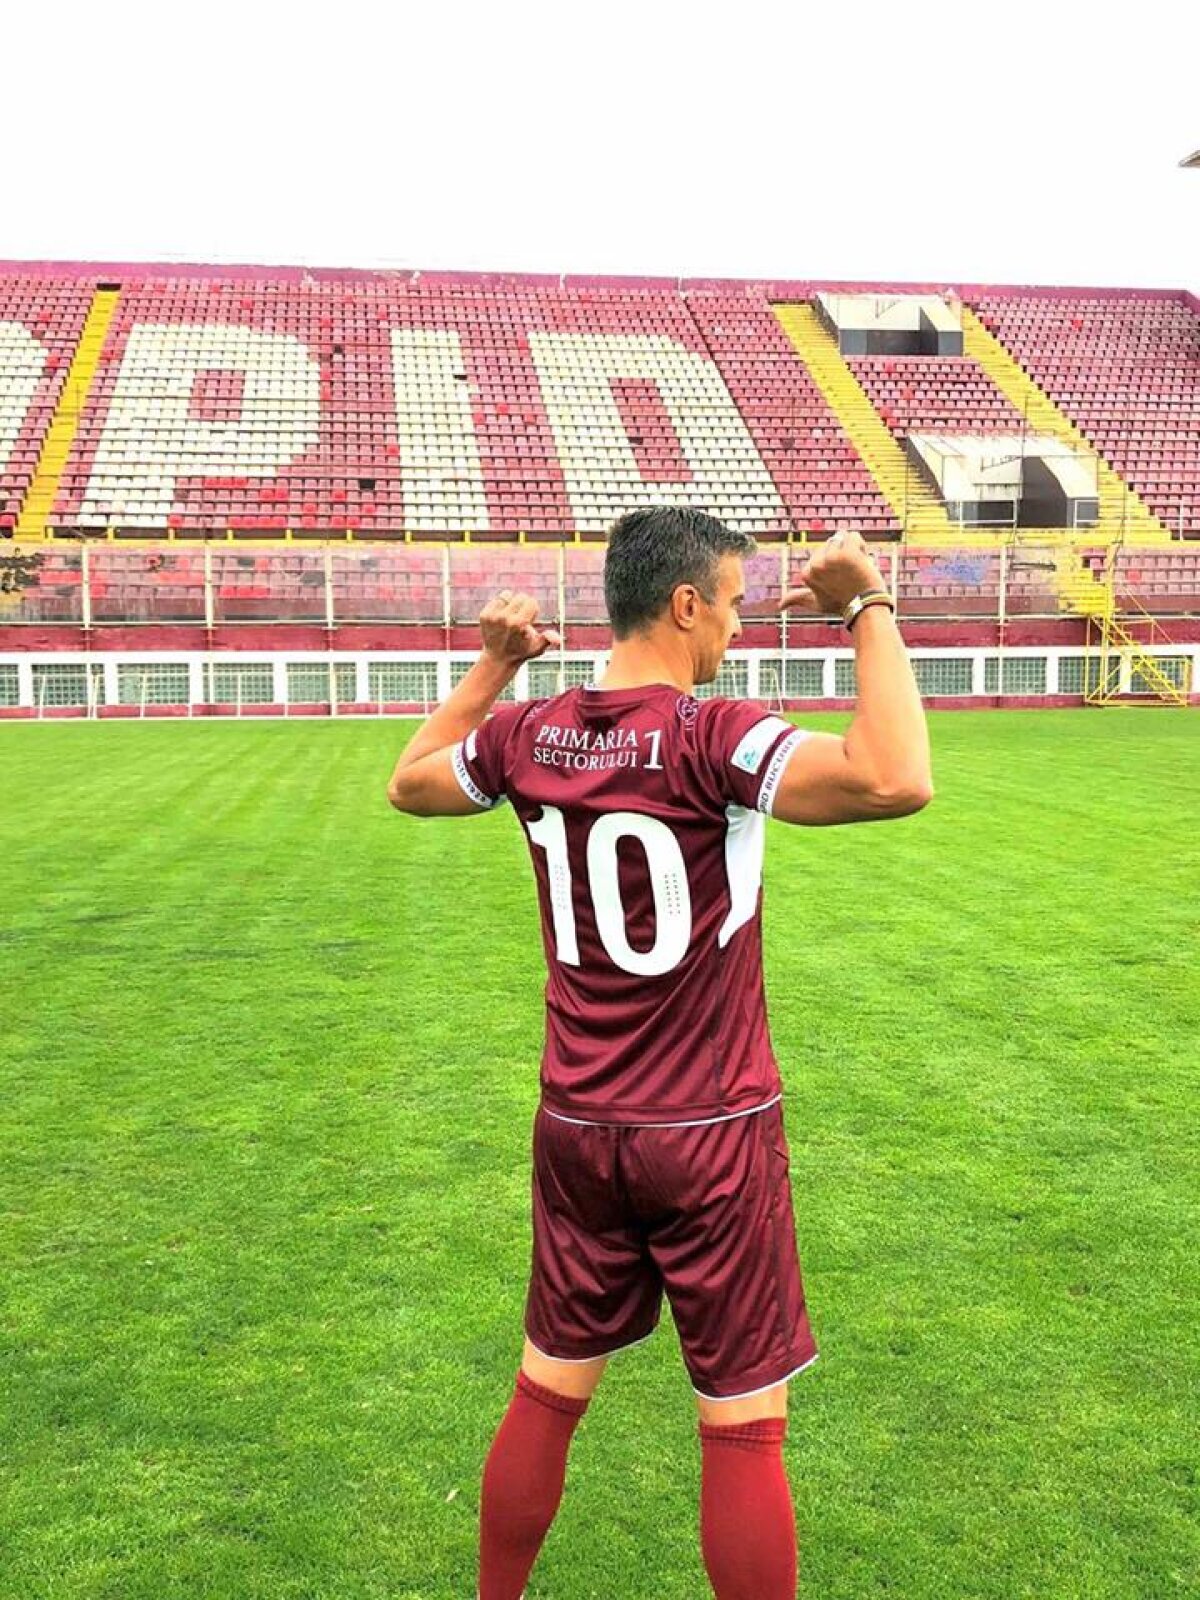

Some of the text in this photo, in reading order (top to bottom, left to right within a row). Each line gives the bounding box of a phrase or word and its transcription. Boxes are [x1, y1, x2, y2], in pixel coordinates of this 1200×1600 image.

[534, 725, 639, 751] PRIMARIA
[643, 729, 664, 770] 1
[533, 746, 639, 771] SECTORULUI
[526, 804, 693, 977] 10
